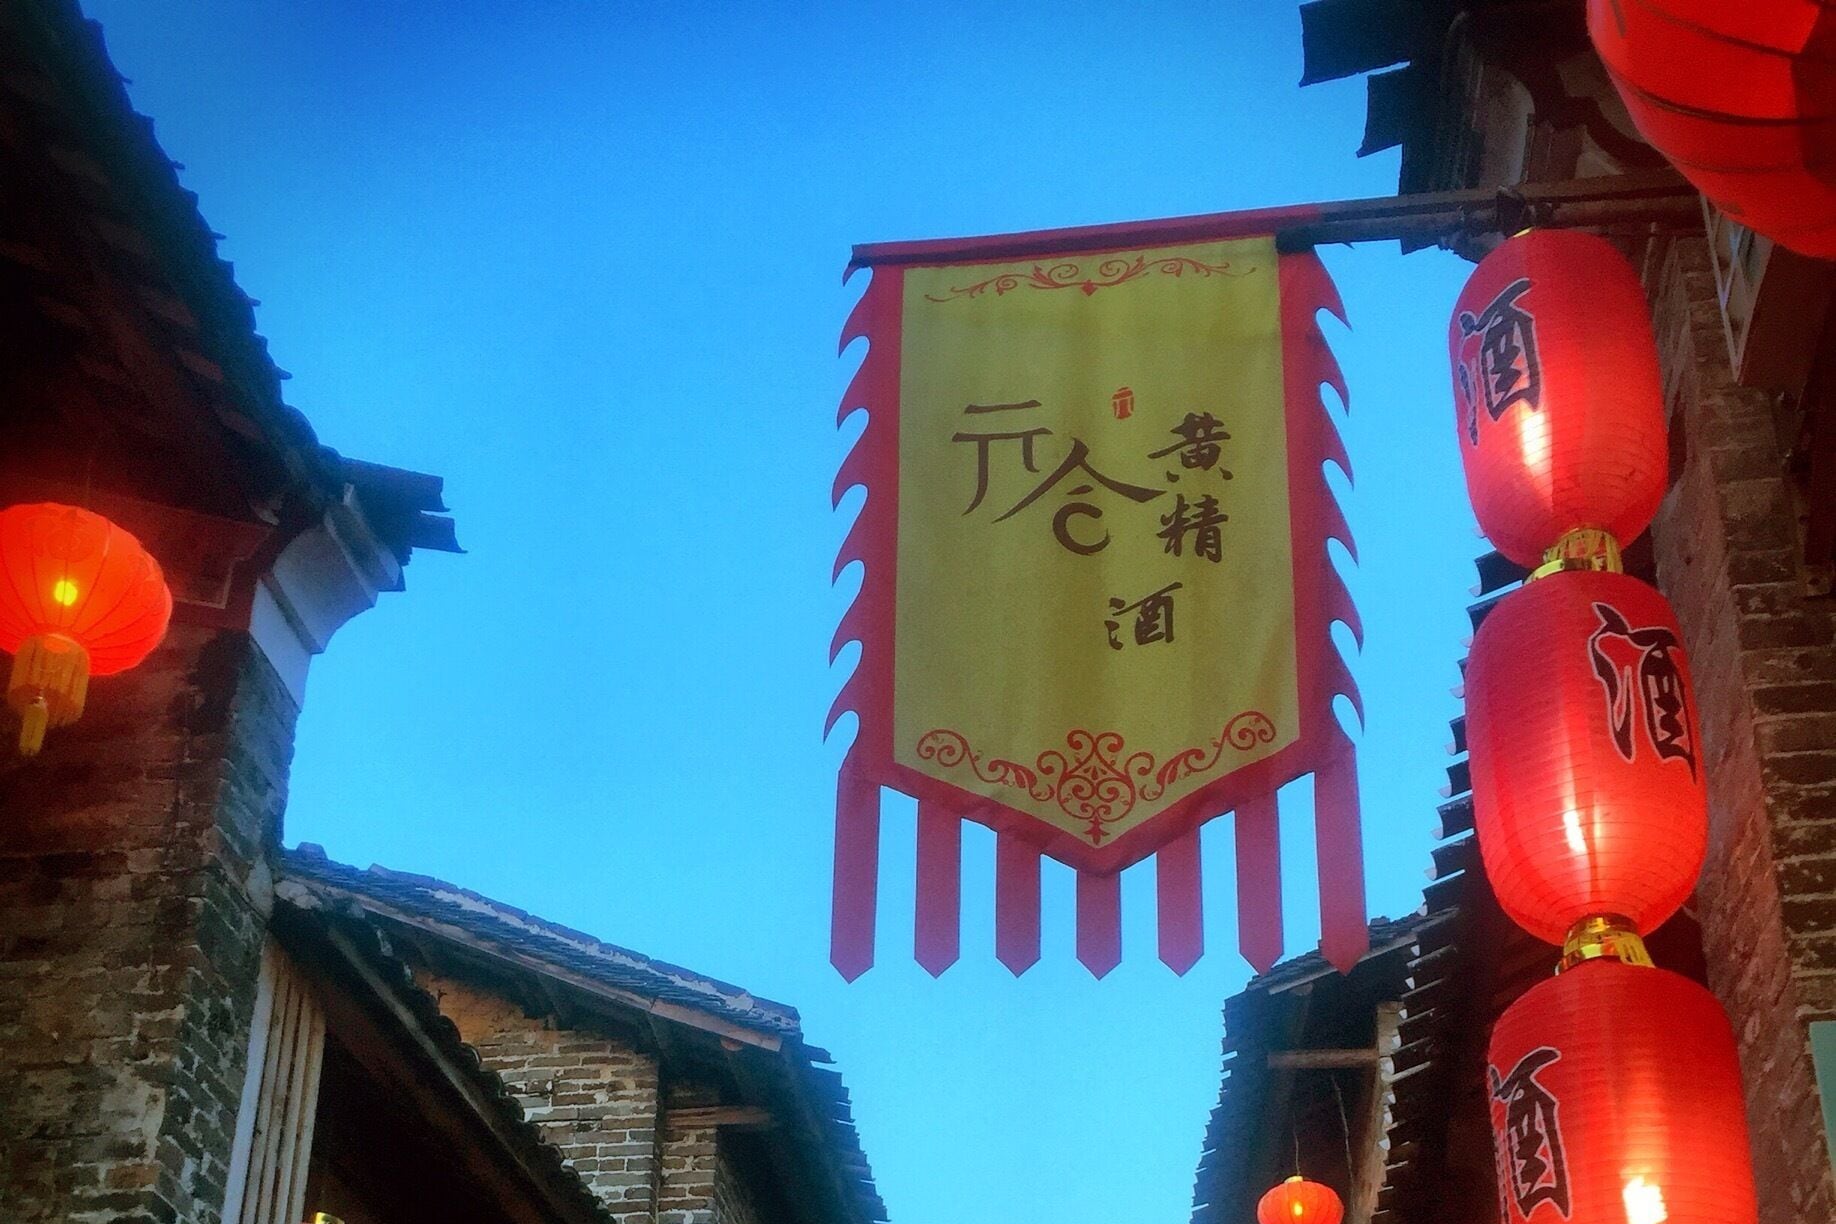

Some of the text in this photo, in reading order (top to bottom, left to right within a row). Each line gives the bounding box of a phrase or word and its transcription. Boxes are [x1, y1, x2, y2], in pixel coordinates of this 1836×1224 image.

[1459, 277, 1541, 446] 酒
[1106, 582, 1183, 650] 酒
[1587, 602, 1698, 785] 酒
